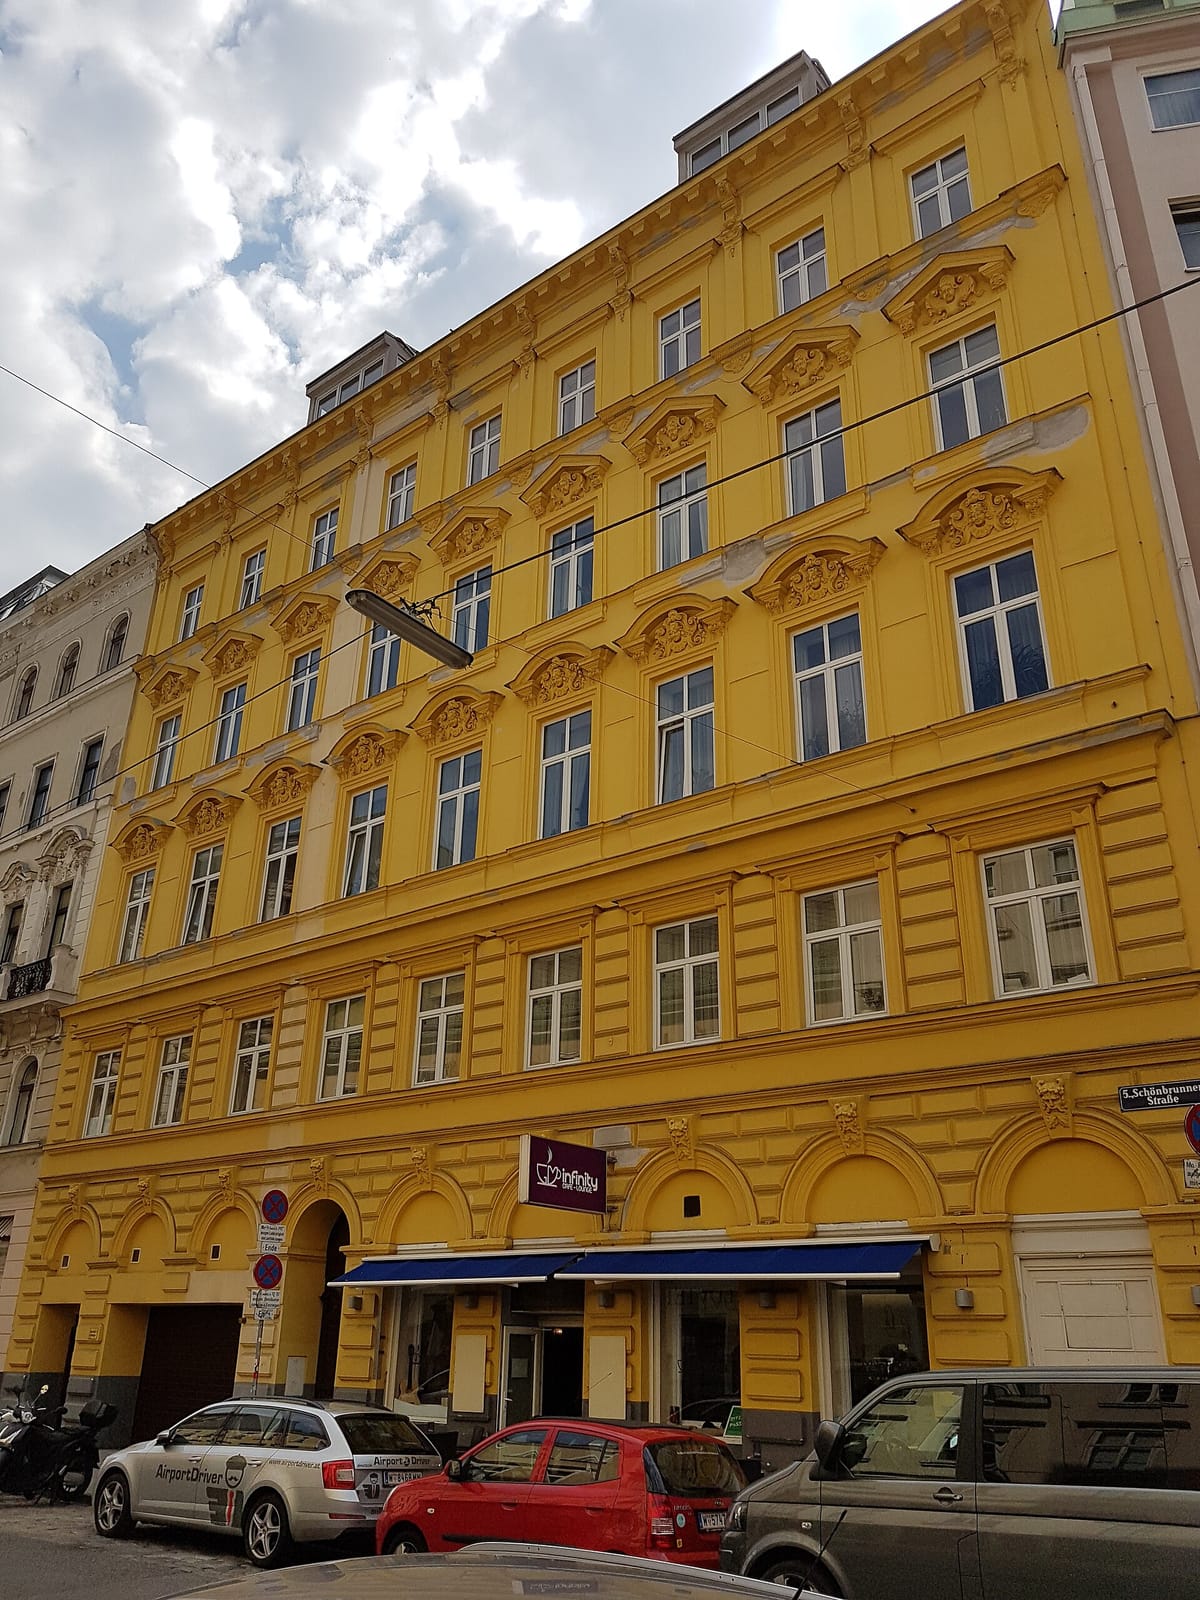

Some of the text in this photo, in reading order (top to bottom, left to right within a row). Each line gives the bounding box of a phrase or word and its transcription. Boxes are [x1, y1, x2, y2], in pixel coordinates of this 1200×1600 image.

[1147, 1094, 1180, 1106] Straße
[562, 1168, 598, 1191] infinity
[373, 1456, 430, 1467] Airport Driver
[155, 1464, 223, 1485] AirportDriver
